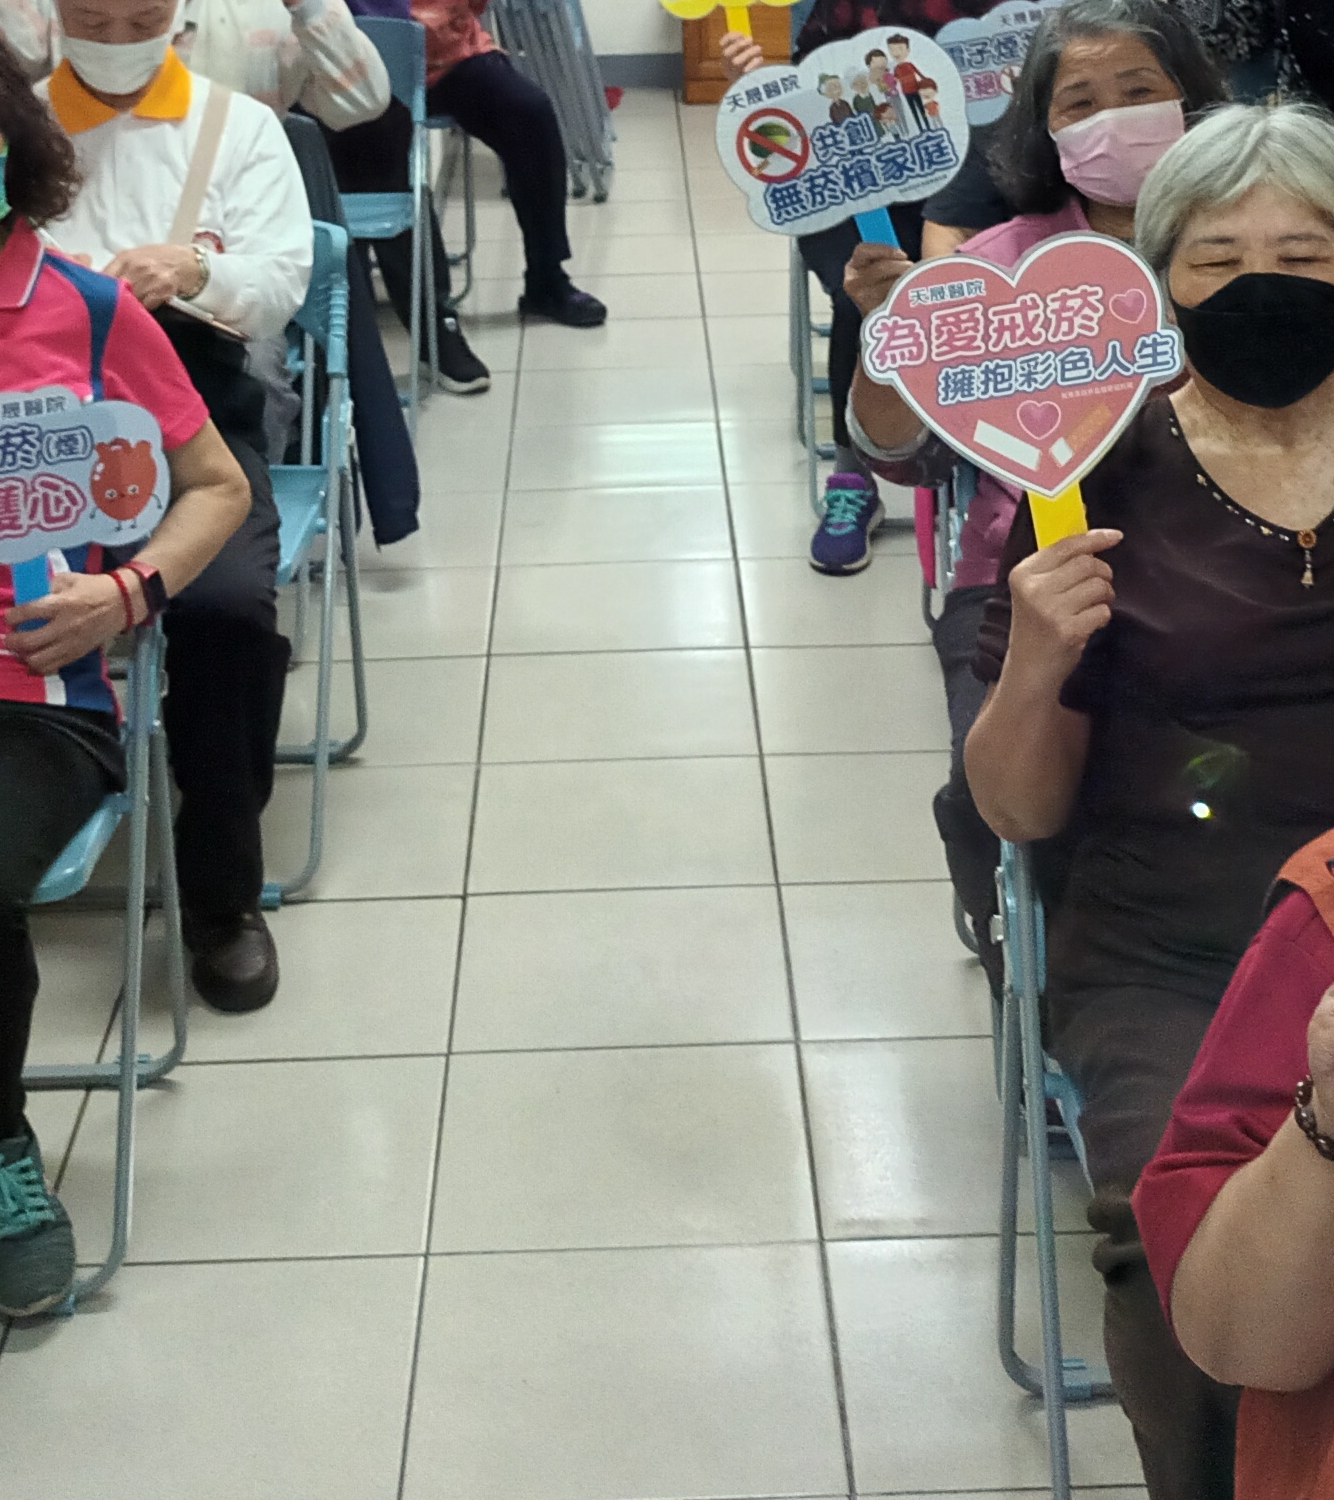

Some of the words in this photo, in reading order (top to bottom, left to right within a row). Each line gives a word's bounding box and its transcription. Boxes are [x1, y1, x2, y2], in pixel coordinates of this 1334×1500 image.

[724, 74, 801, 112] 天晟醫院
[810, 113, 879, 164] 共創
[764, 126, 959, 224] 無菸檳家庭
[909, 279, 986, 307] 天晟醫院
[869, 285, 1104, 370] 為愛戒菸
[938, 331, 1179, 406] 擁抱彩色人生
